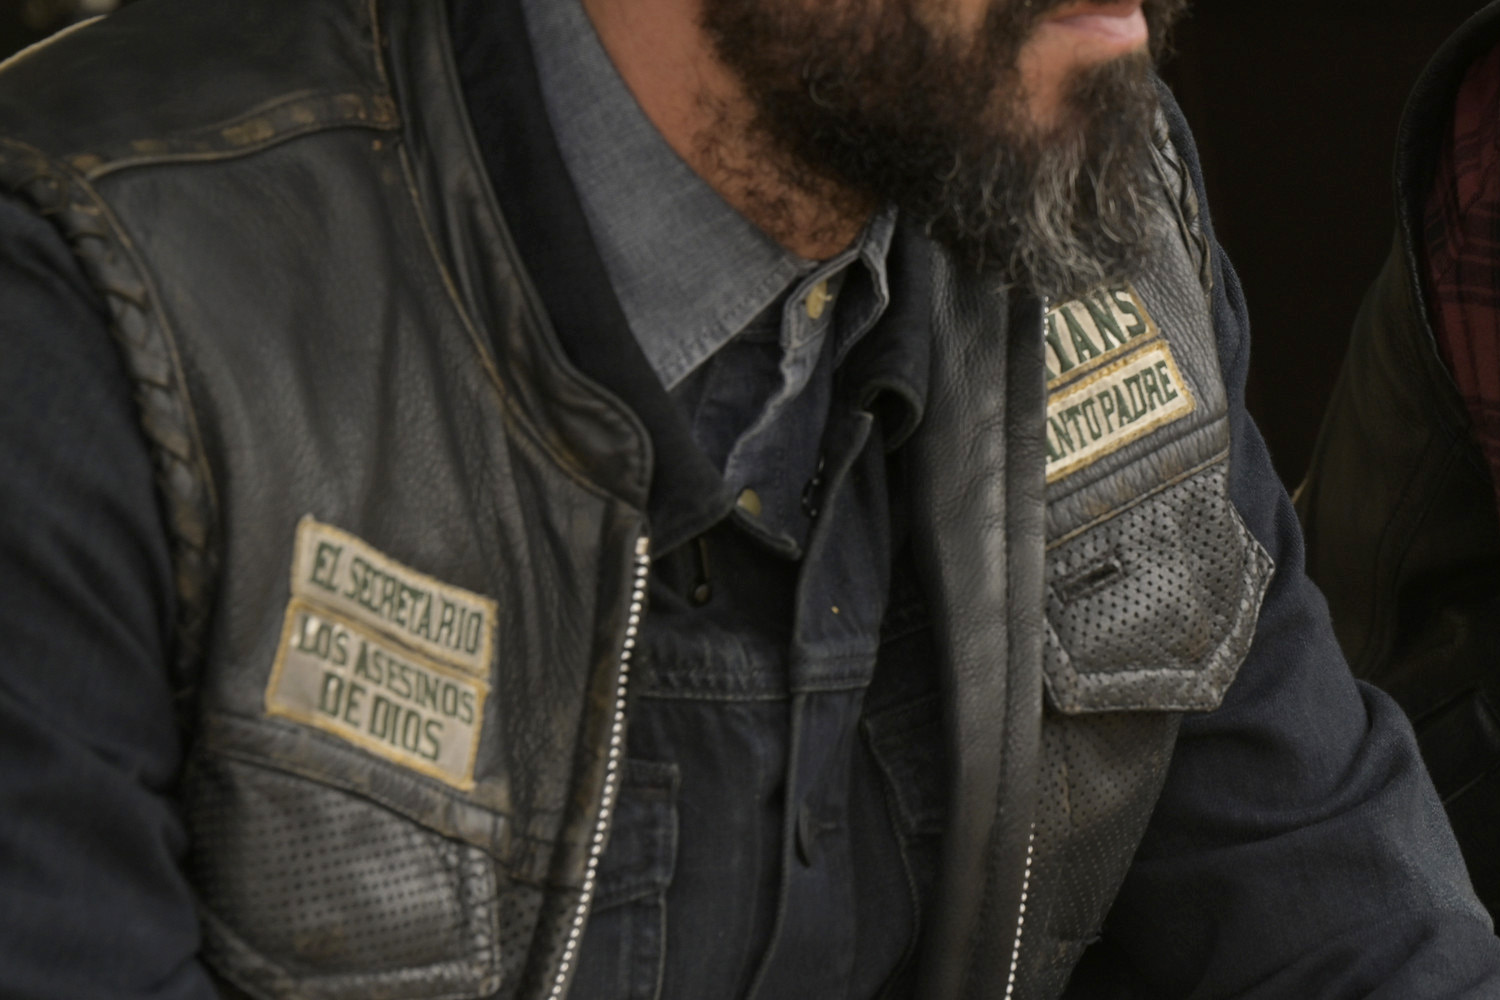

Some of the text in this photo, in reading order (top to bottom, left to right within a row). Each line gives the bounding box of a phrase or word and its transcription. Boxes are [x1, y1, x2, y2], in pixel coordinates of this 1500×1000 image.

[1046, 288, 1146, 380] YANS
[345, 557, 482, 655] SECRETARIO
[299, 616, 474, 725] LOS ASESINOS
[319, 673, 443, 761] DE DIOS
